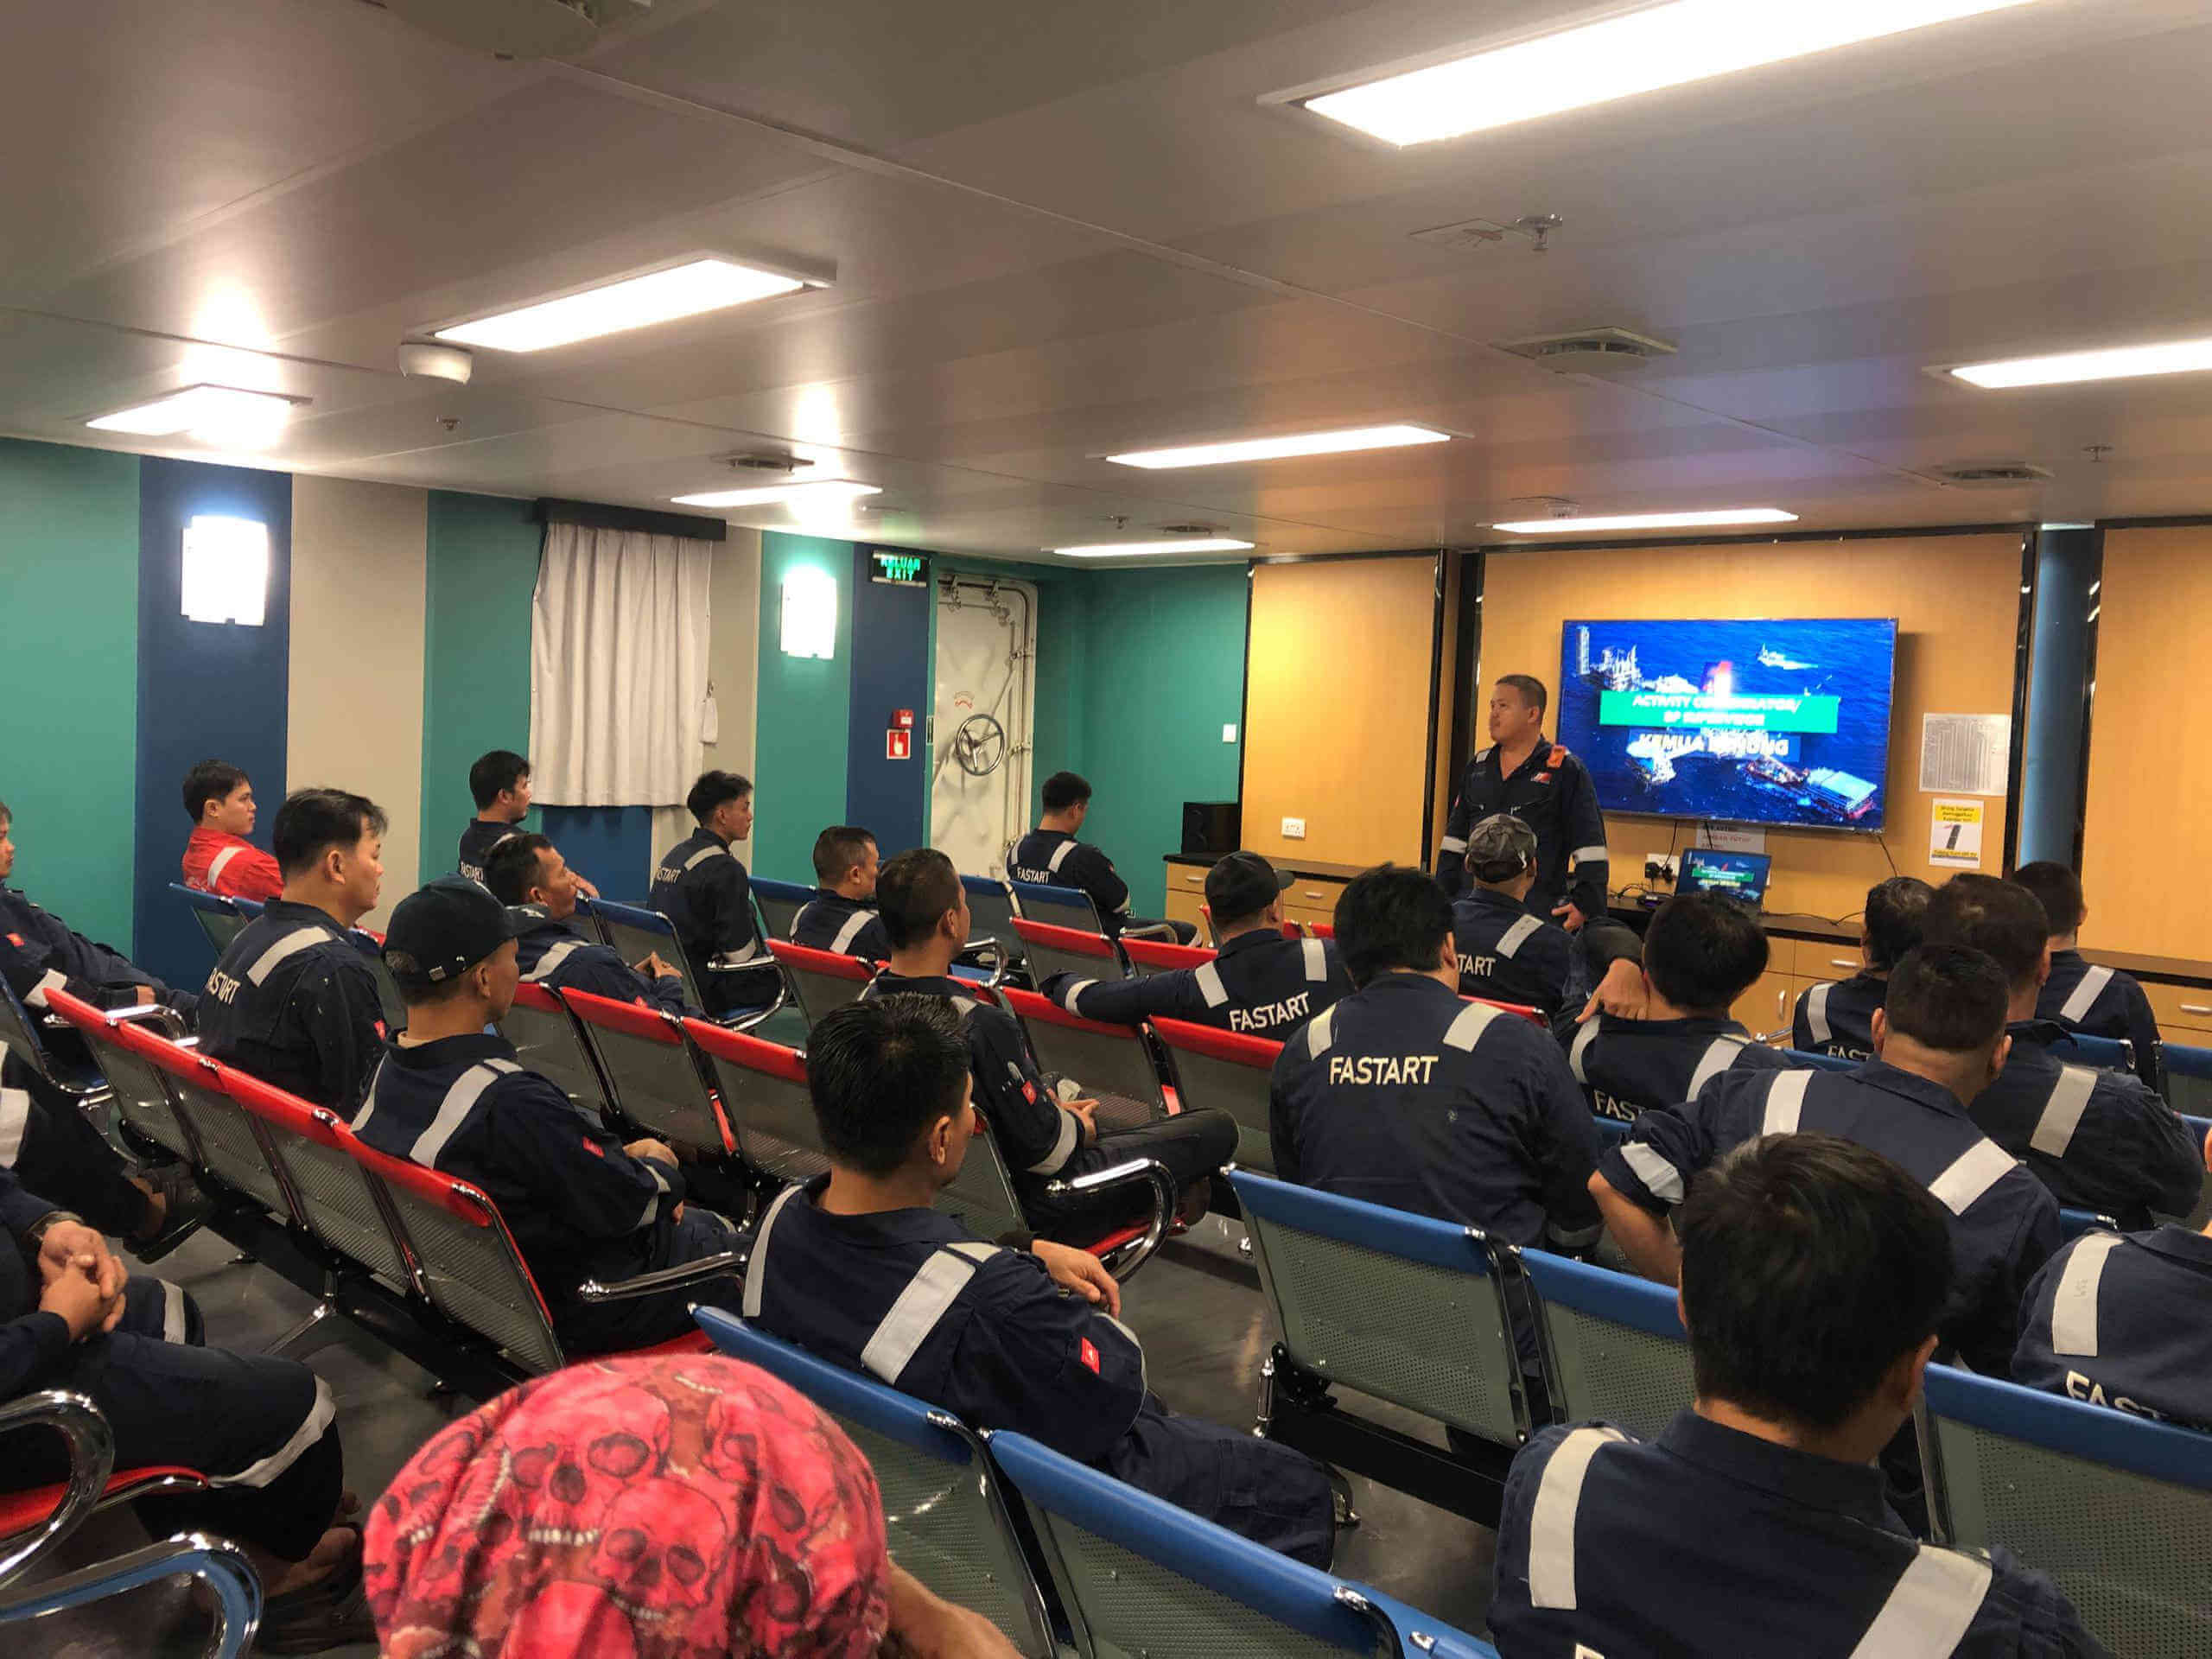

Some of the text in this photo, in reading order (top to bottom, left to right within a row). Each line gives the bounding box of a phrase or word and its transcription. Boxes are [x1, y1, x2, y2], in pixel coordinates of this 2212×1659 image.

[886, 566, 915, 582] EXIT
[1632, 696, 1692, 708] ACTIVITY
[1017, 867, 1050, 885] FASTART
[1230, 991, 1311, 1032] FASTART
[1328, 1055, 1439, 1086] FASTART
